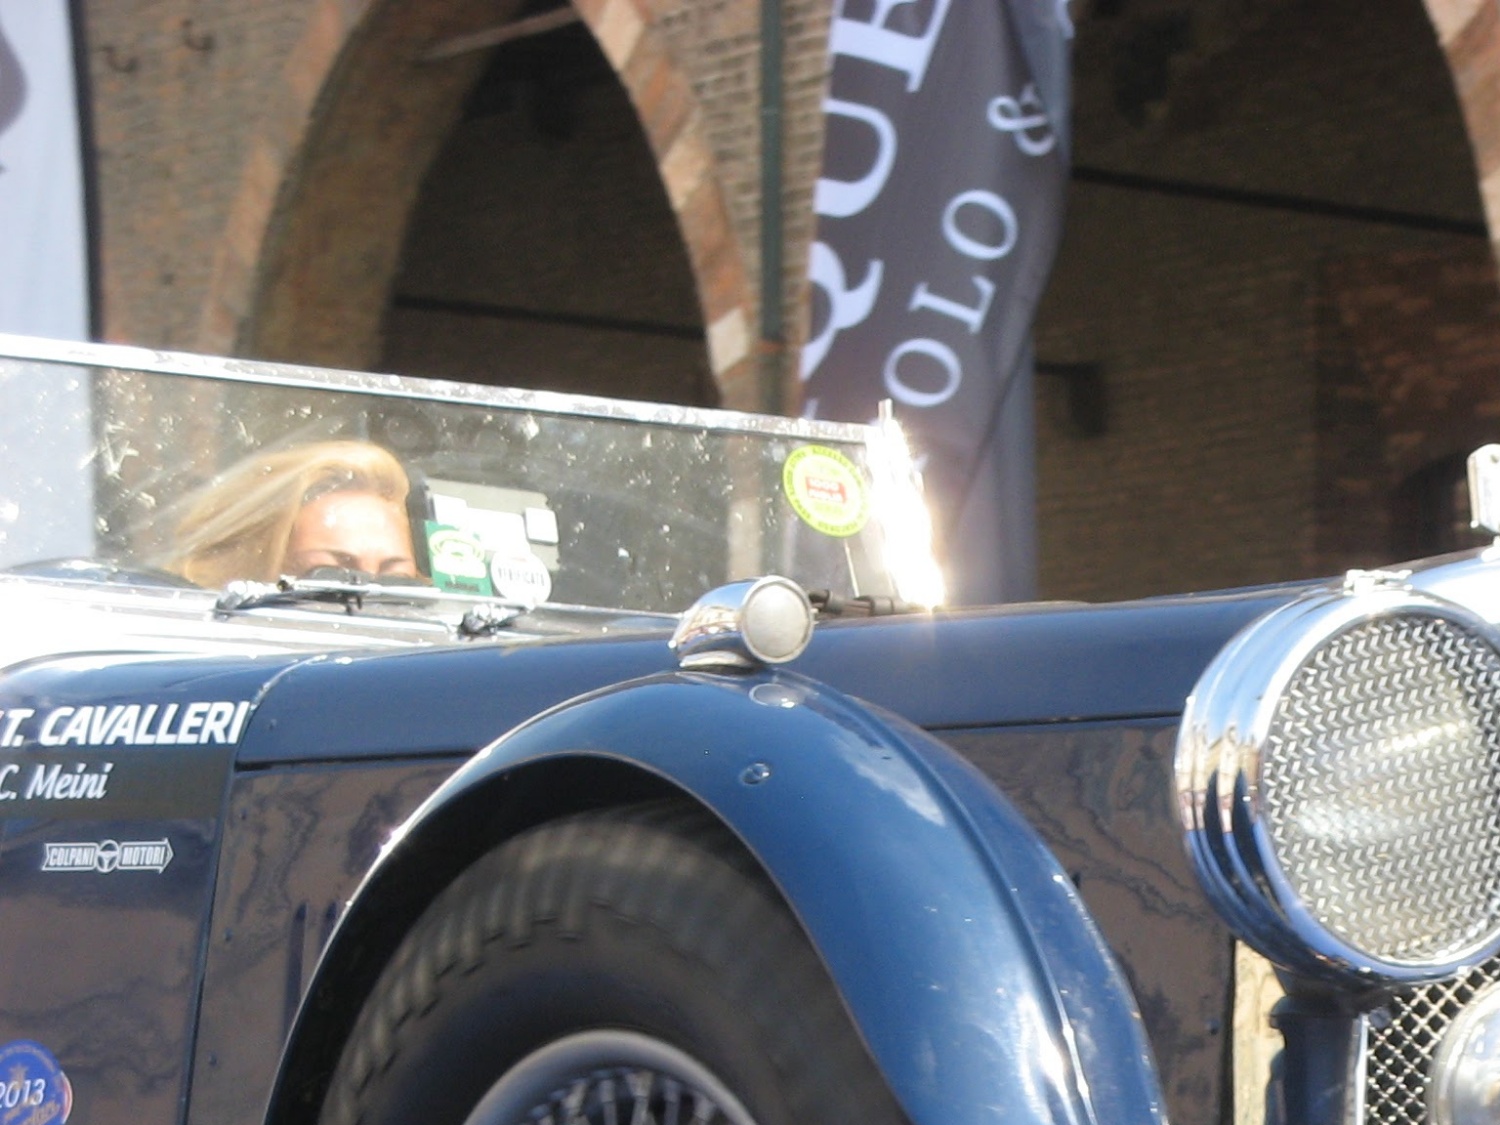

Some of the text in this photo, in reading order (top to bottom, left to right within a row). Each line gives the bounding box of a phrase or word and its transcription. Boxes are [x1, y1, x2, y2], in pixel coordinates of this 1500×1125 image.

[872, 190, 1018, 425] OLO
[0, 700, 250, 747] T. CAVALLERI
[26, 762, 114, 800] Meini
[49, 845, 166, 866] COLPANI MOTORI
